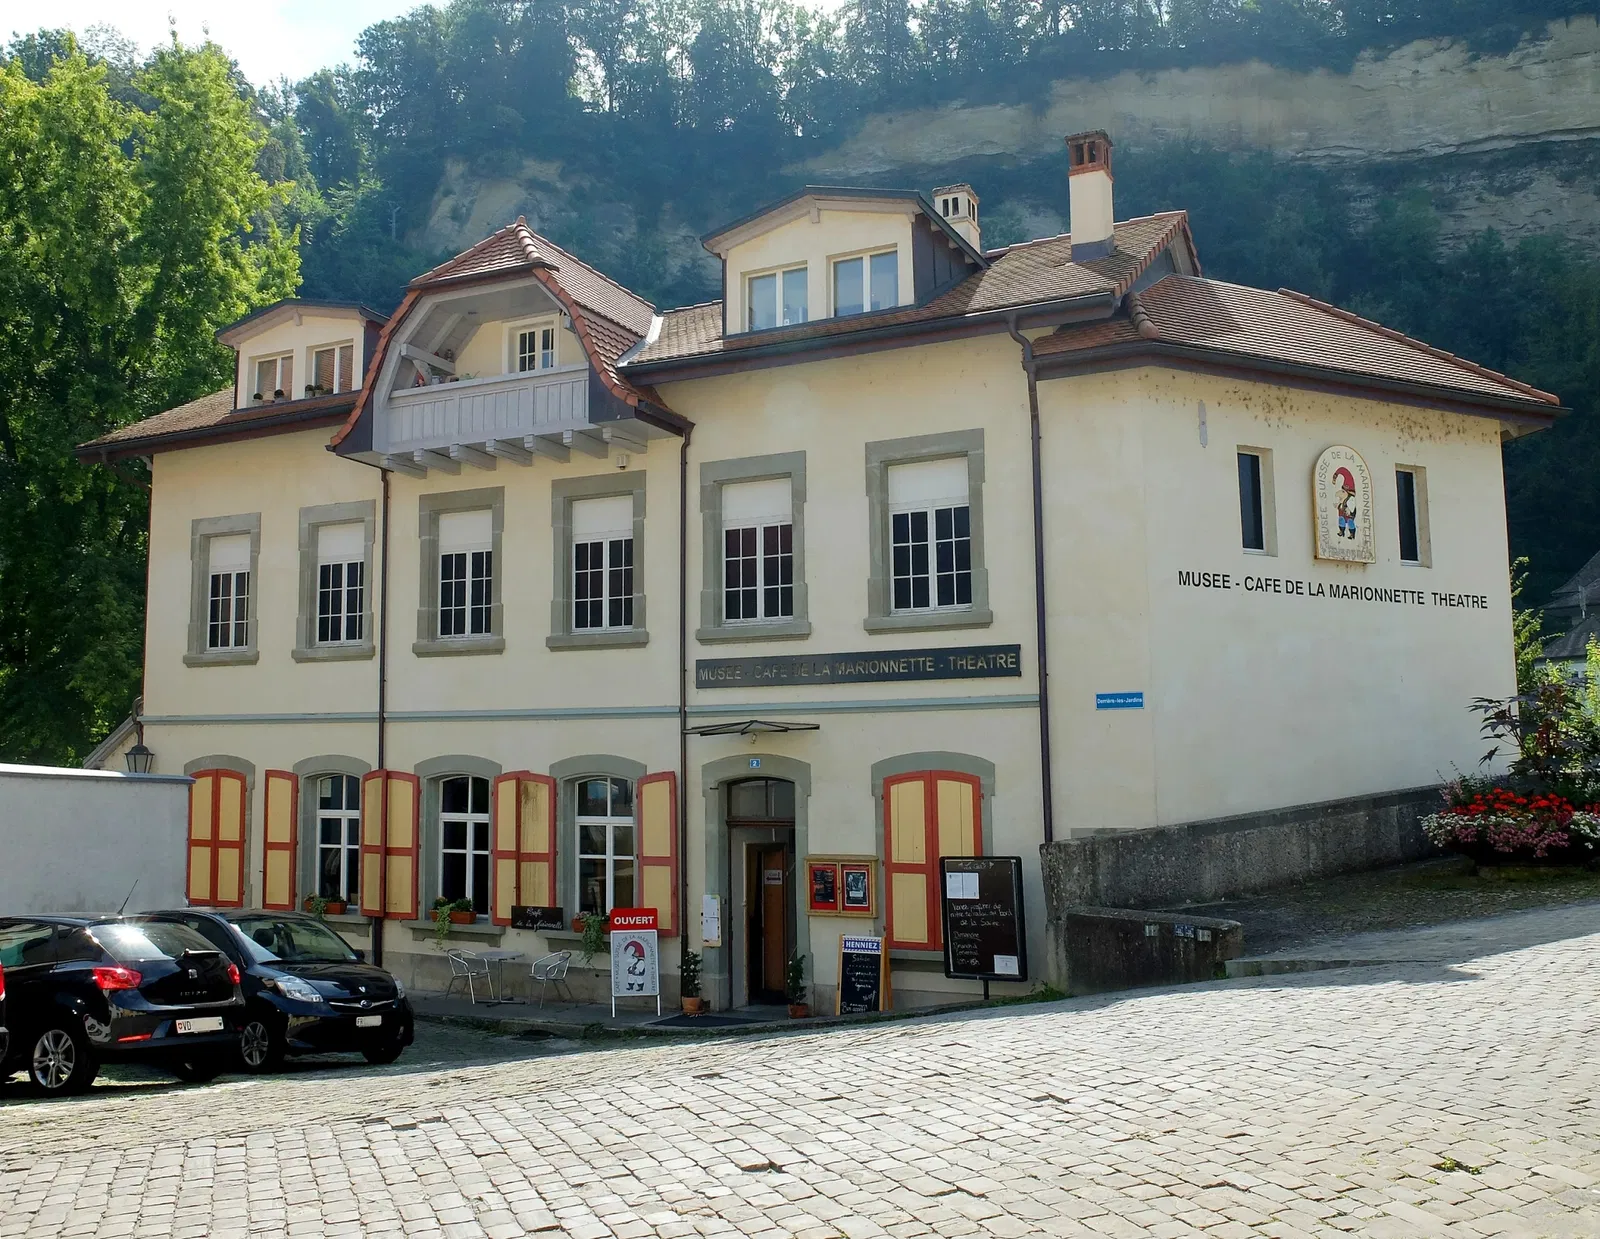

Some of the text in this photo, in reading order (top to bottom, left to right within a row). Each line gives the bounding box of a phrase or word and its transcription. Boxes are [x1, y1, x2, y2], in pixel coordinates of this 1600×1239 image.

[1318, 459, 1331, 499] SUISSE
[1331, 451, 1341, 460] DE
[1345, 452, 1355, 463] LA
[1178, 570, 1231, 590] MUSEE
[1244, 576, 1282, 595] CAFE
[1285, 579, 1304, 596] DE
[1308, 582, 1326, 598] LA
[1329, 583, 1425, 606] MARIONNETTE
[1431, 591, 1488, 610] THEATRE
[698, 664, 742, 681] MUSEE
[791, 661, 809, 677] DE
[812, 660, 831, 677] LA
[835, 655, 935, 676] MARIONNETTE
[948, 653, 1017, 671] THEATRE
[614, 916, 654, 925] OUVERT
[846, 941, 878, 949] HENNIEZ
[182, 1020, 192, 1031] VD
